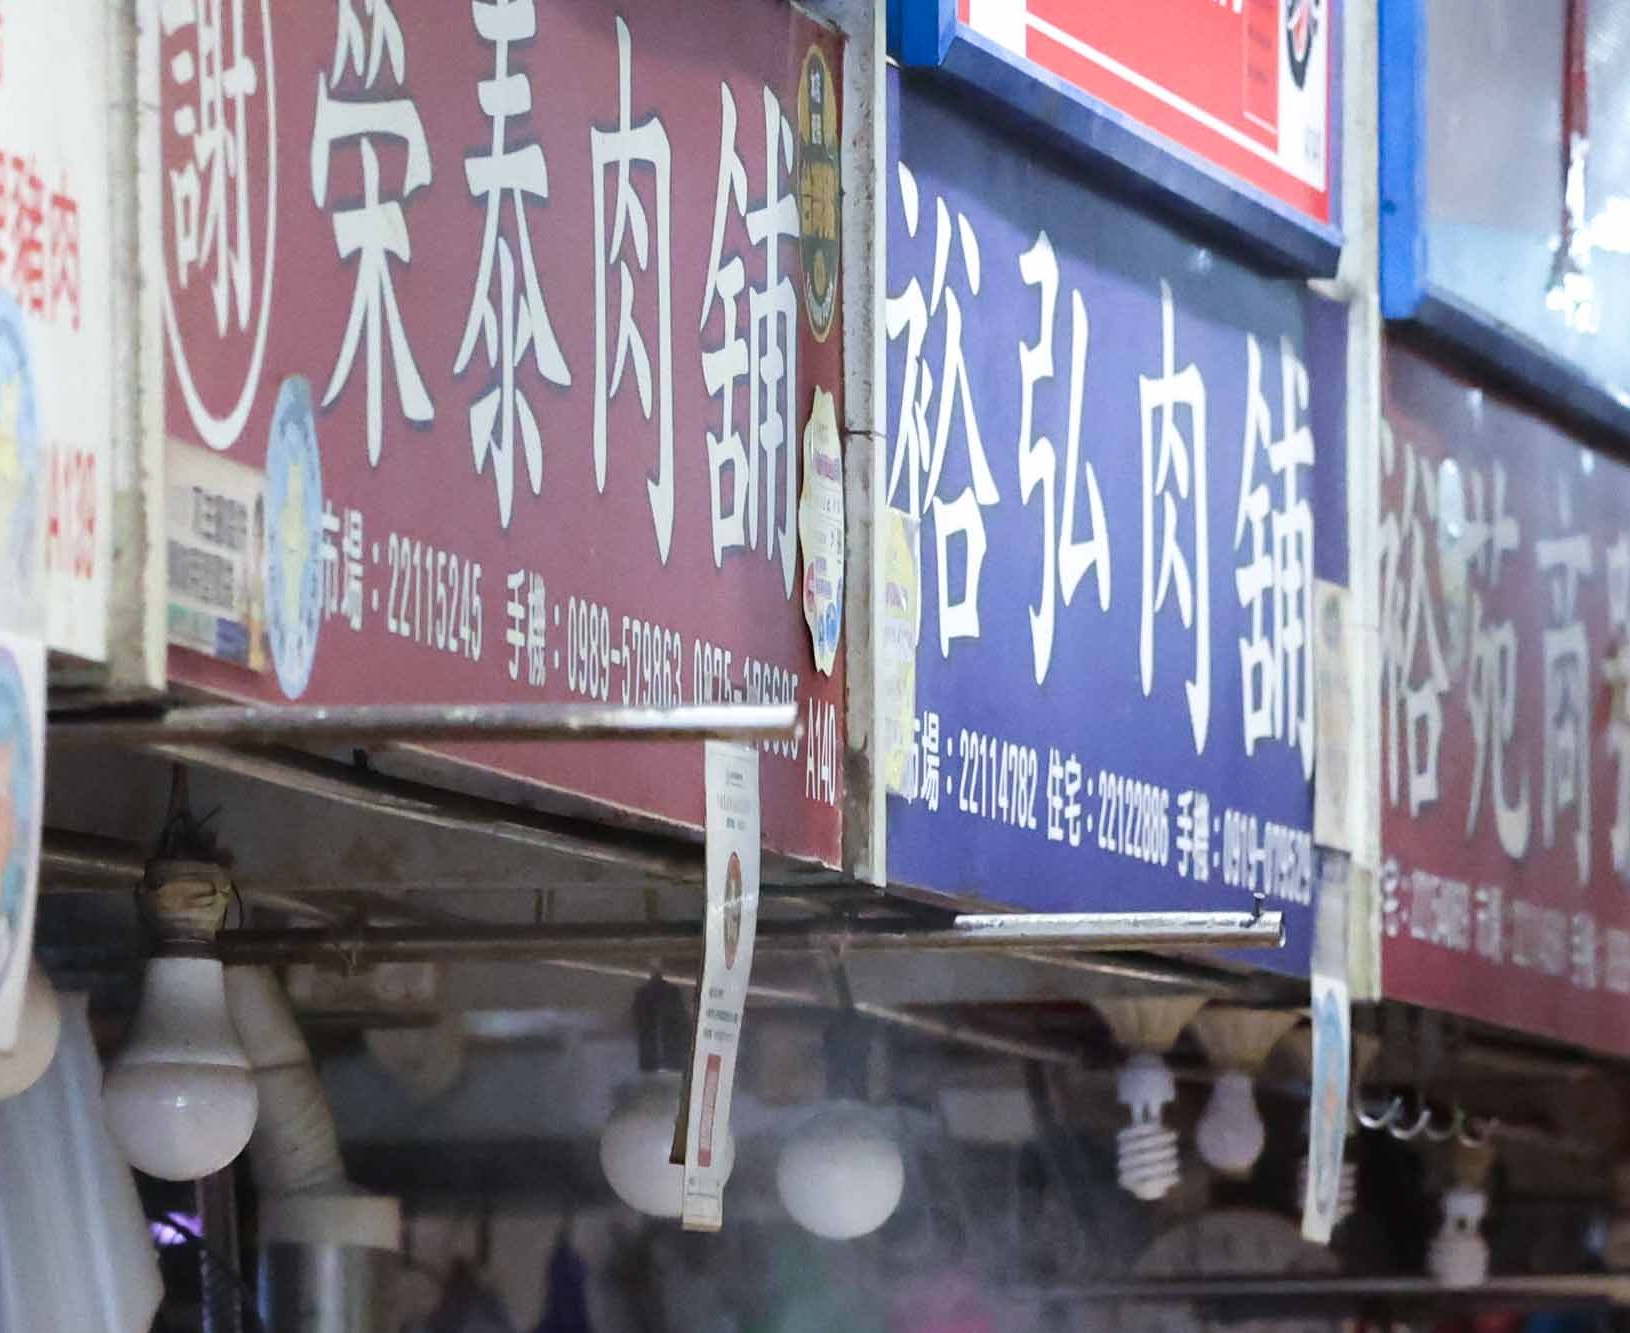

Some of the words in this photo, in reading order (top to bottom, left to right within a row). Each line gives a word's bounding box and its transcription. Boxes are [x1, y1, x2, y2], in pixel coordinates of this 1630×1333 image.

[887, 160, 1315, 782] 裕弘肉舖
[804, 695, 837, 804] A140
